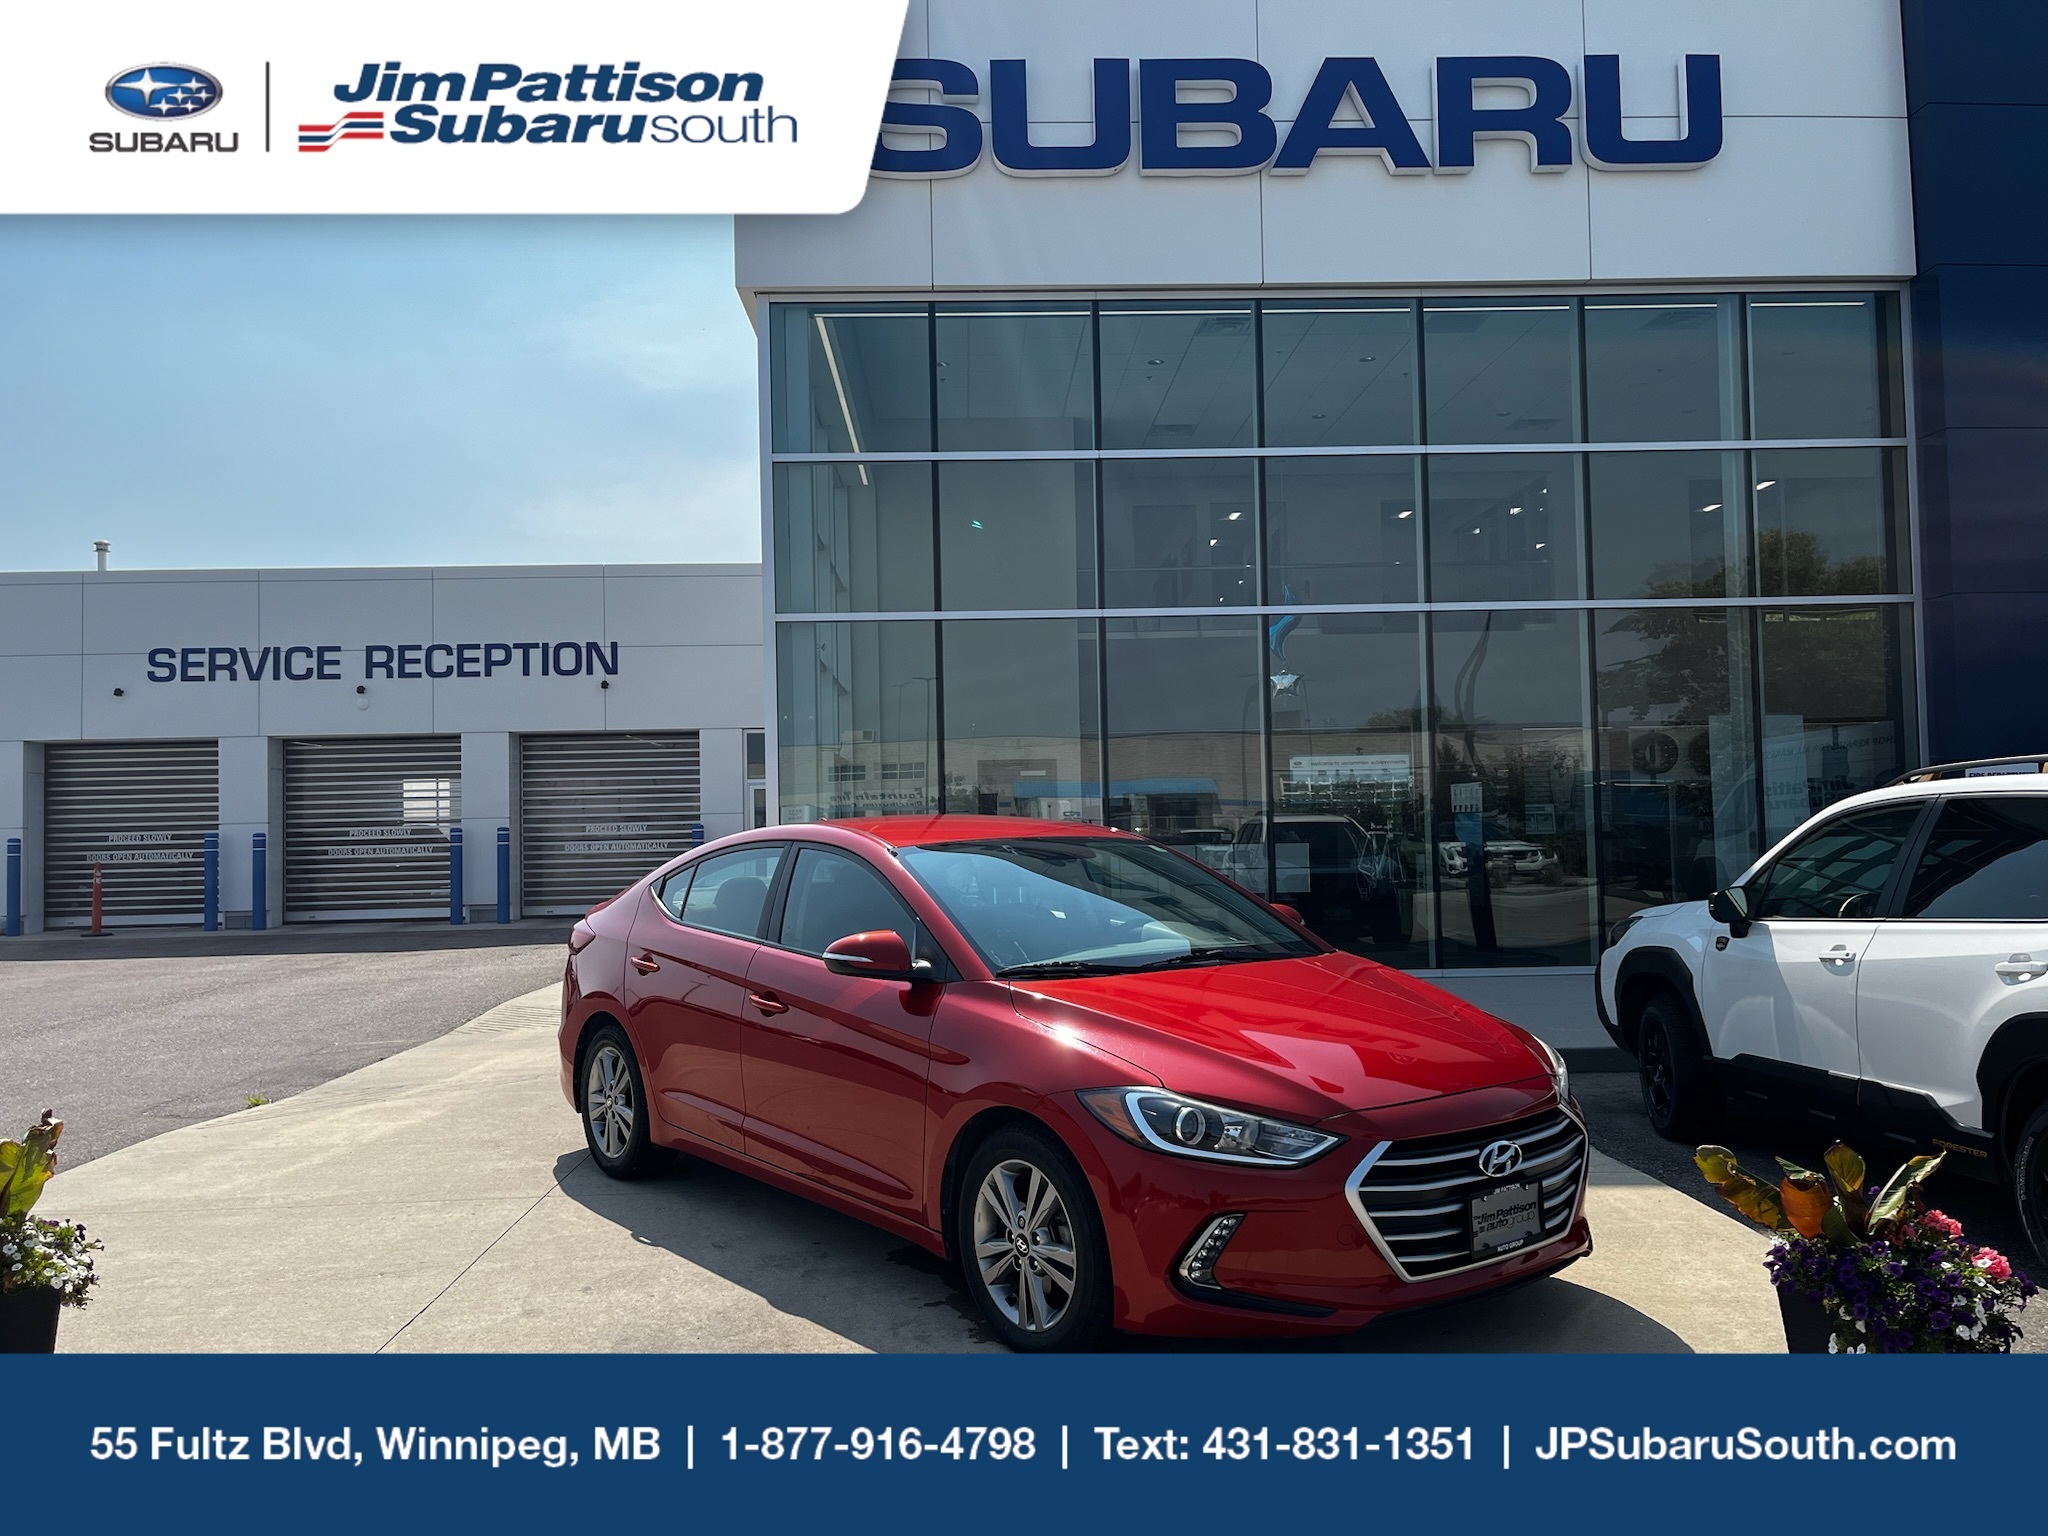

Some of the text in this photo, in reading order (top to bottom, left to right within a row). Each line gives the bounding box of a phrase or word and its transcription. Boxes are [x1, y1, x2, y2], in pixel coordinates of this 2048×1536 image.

[870, 53, 1724, 178] SUBARU
[147, 641, 619, 683] SERVICE RECEPTION
[349, 828, 412, 837] PROCEED SLOWLY
[585, 824, 648, 833] PROCEED SLOWLY
[108, 833, 173, 843] PROCEED SLOWLY
[327, 846, 434, 856] DOORS OPEN AUTOMATICALLY
[564, 842, 669, 852] DOORS OPEN AUTOMATICALLY
[86, 851, 194, 862] DOORS OPEN AUTOMATICALLY
[1932, 1138, 1988, 1160] FORESTER
[1497, 1239, 1524, 1252] AUTO GROUP
